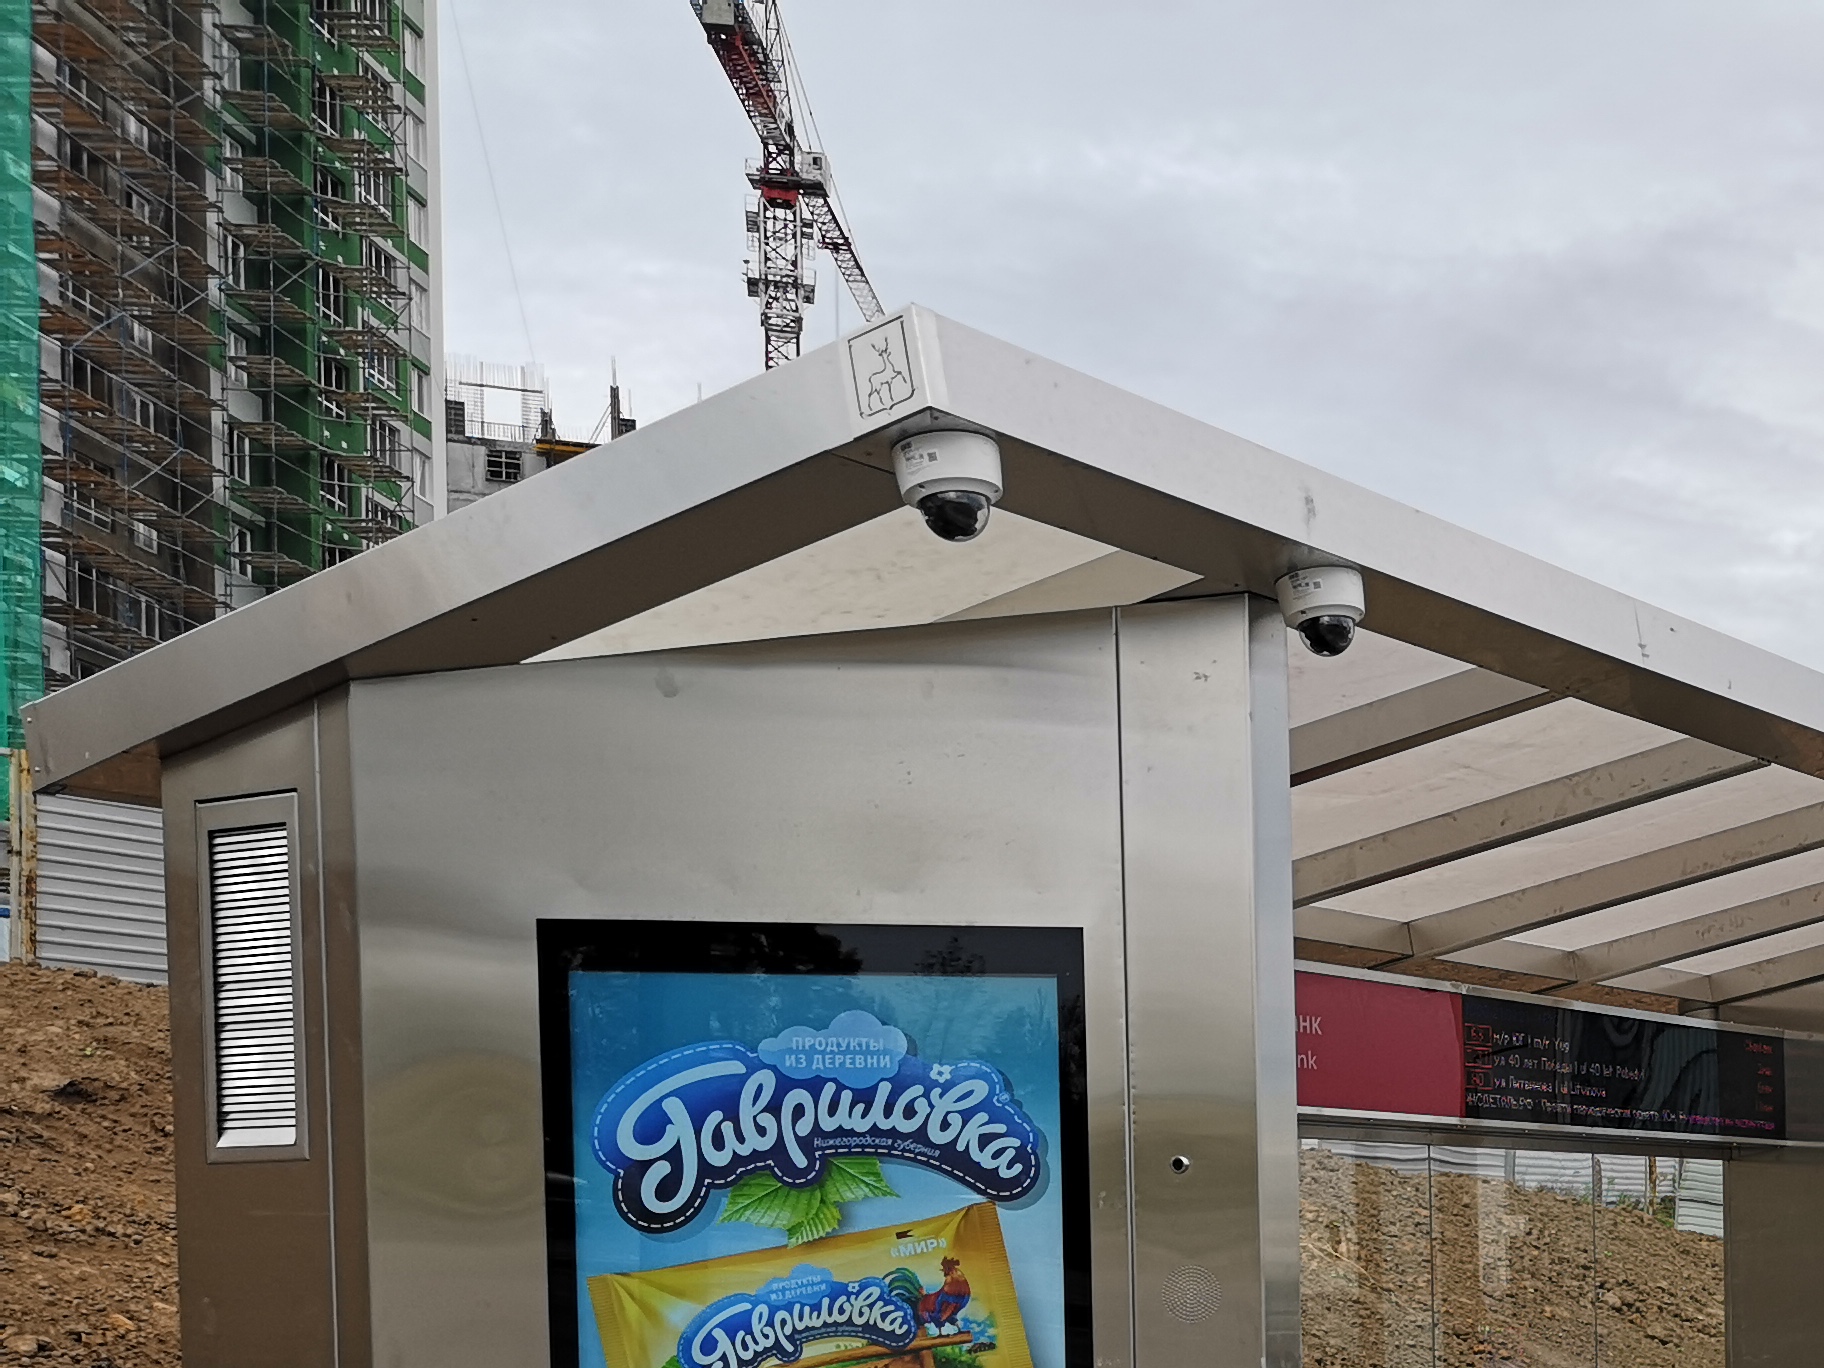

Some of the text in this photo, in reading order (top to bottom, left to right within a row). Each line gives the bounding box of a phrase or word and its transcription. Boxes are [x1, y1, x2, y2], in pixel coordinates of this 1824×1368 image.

[791, 1036, 884, 1052] ПРОДУКТЫ
[785, 1053, 892, 1070] ИЗ ДЕРЕВНИ
[1297, 1050, 1318, 1070] nk
[616, 1060, 1023, 1214] Гавриловка
[813, 1135, 941, 1158] Нижегородская губерния
[772, 1274, 822, 1291] ПРОДУКТЫ
